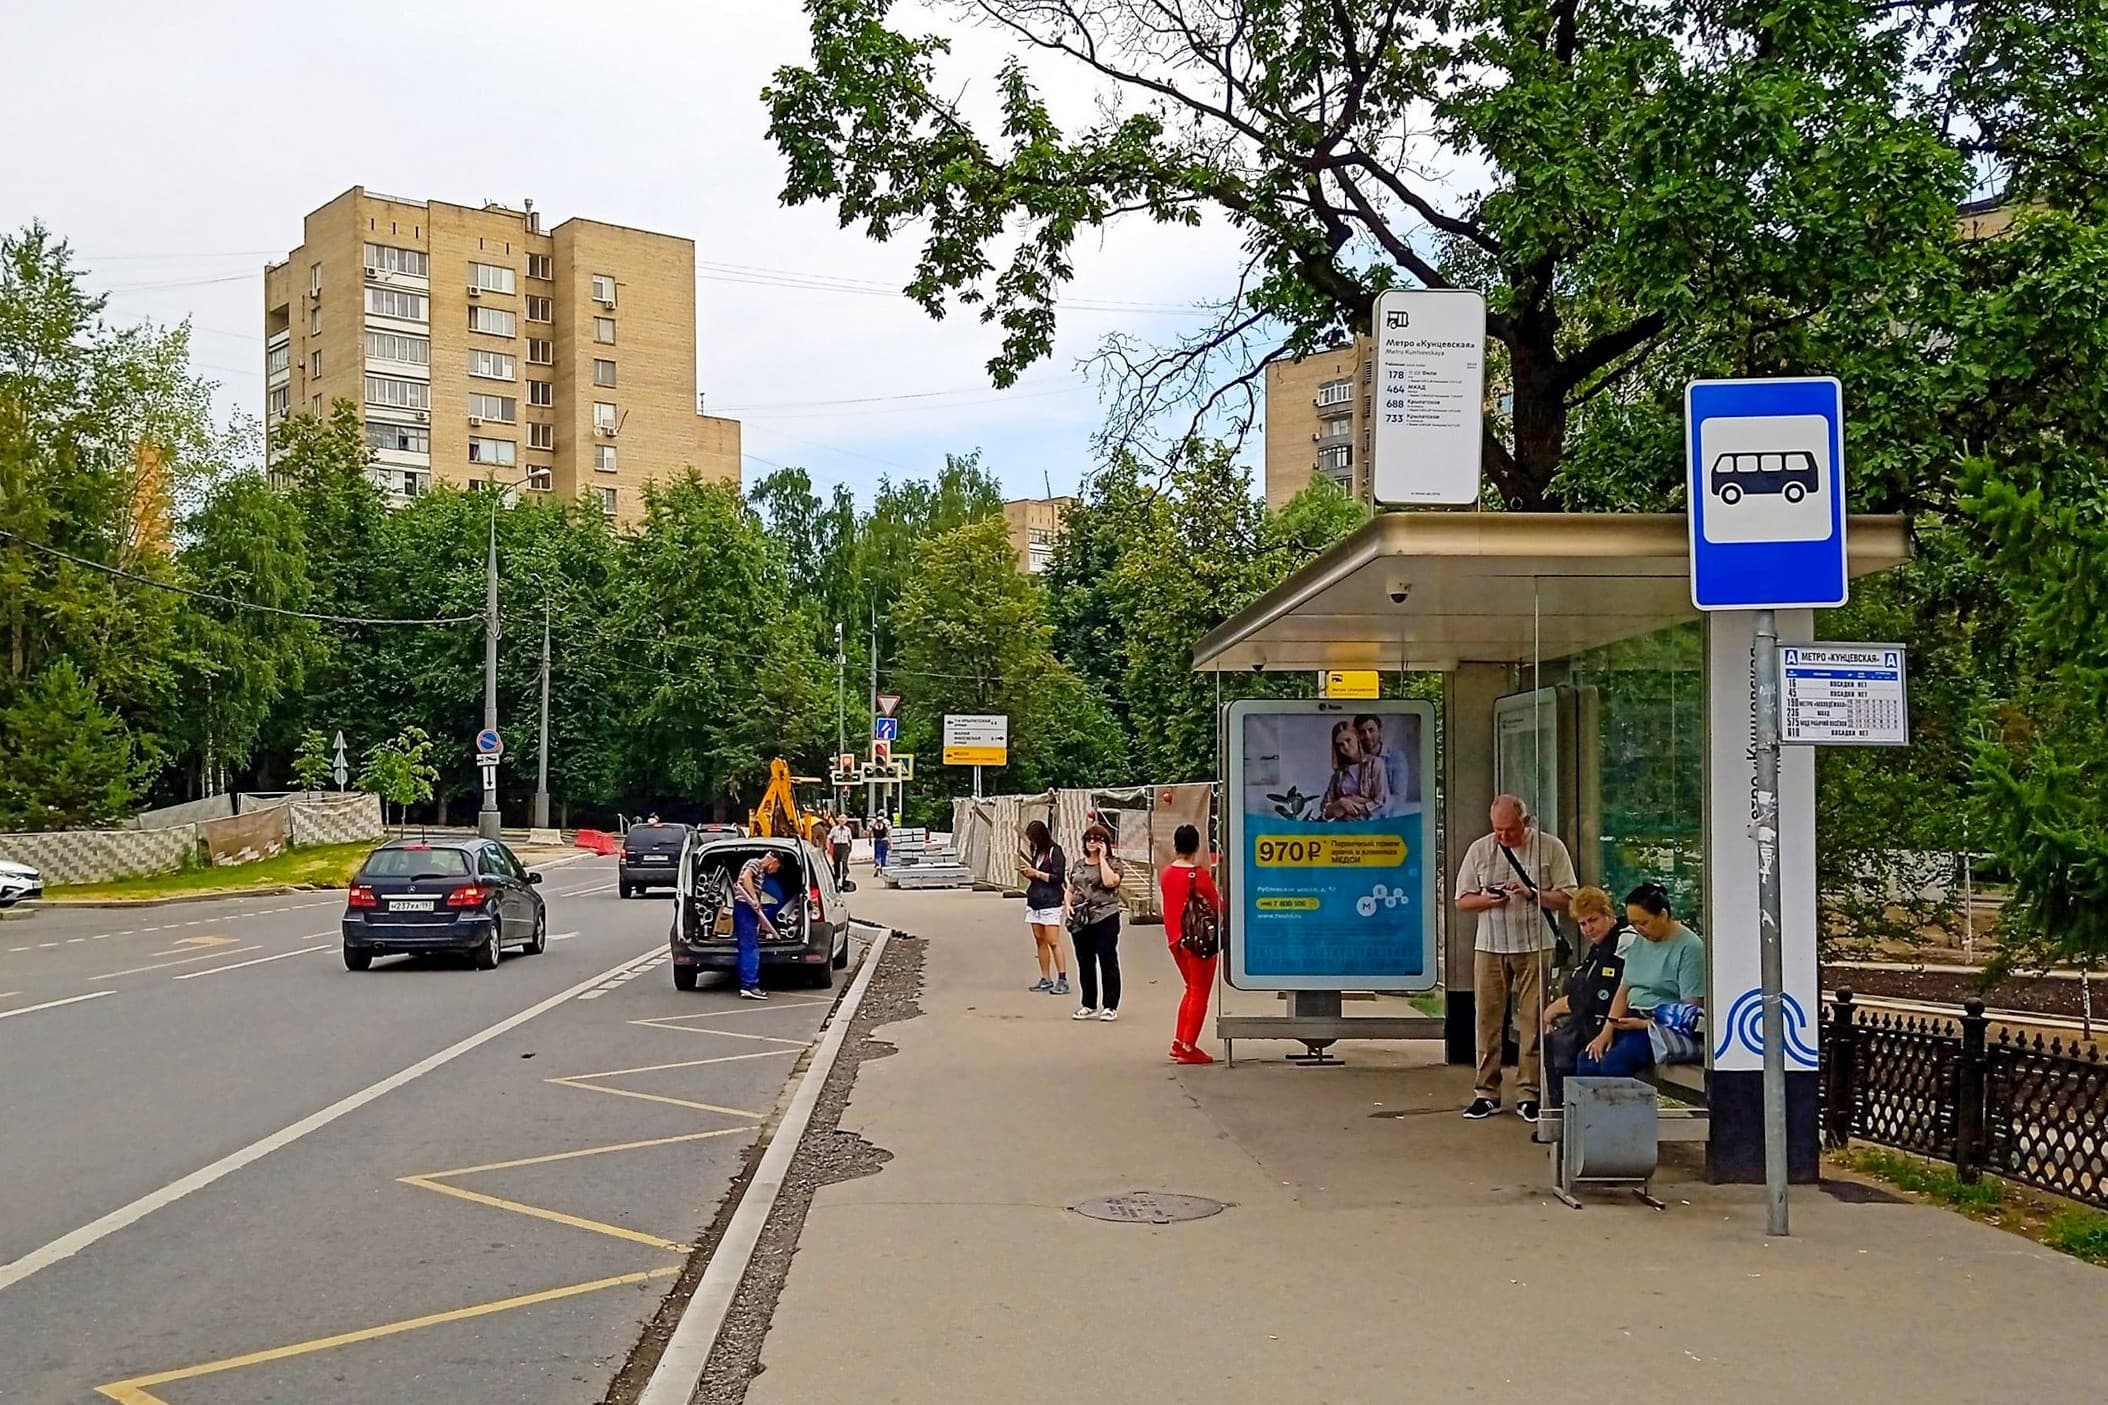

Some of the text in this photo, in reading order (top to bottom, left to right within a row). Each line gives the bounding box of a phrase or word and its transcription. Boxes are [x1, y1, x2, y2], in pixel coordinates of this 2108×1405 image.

[1386, 339, 1475, 349] Метро «Кунцевская»
[1388, 370, 1404, 379] 178
[1387, 385, 1404, 393] 464
[1386, 400, 1404, 408] 688
[1386, 414, 1404, 423] 733
[1786, 651, 1897, 667] А МЕТРО «КУНЦЕВСКАЯ» А
[1789, 688, 1797, 697] 45
[1787, 718, 1799, 727] 575
[1259, 841, 1304, 862] 970
